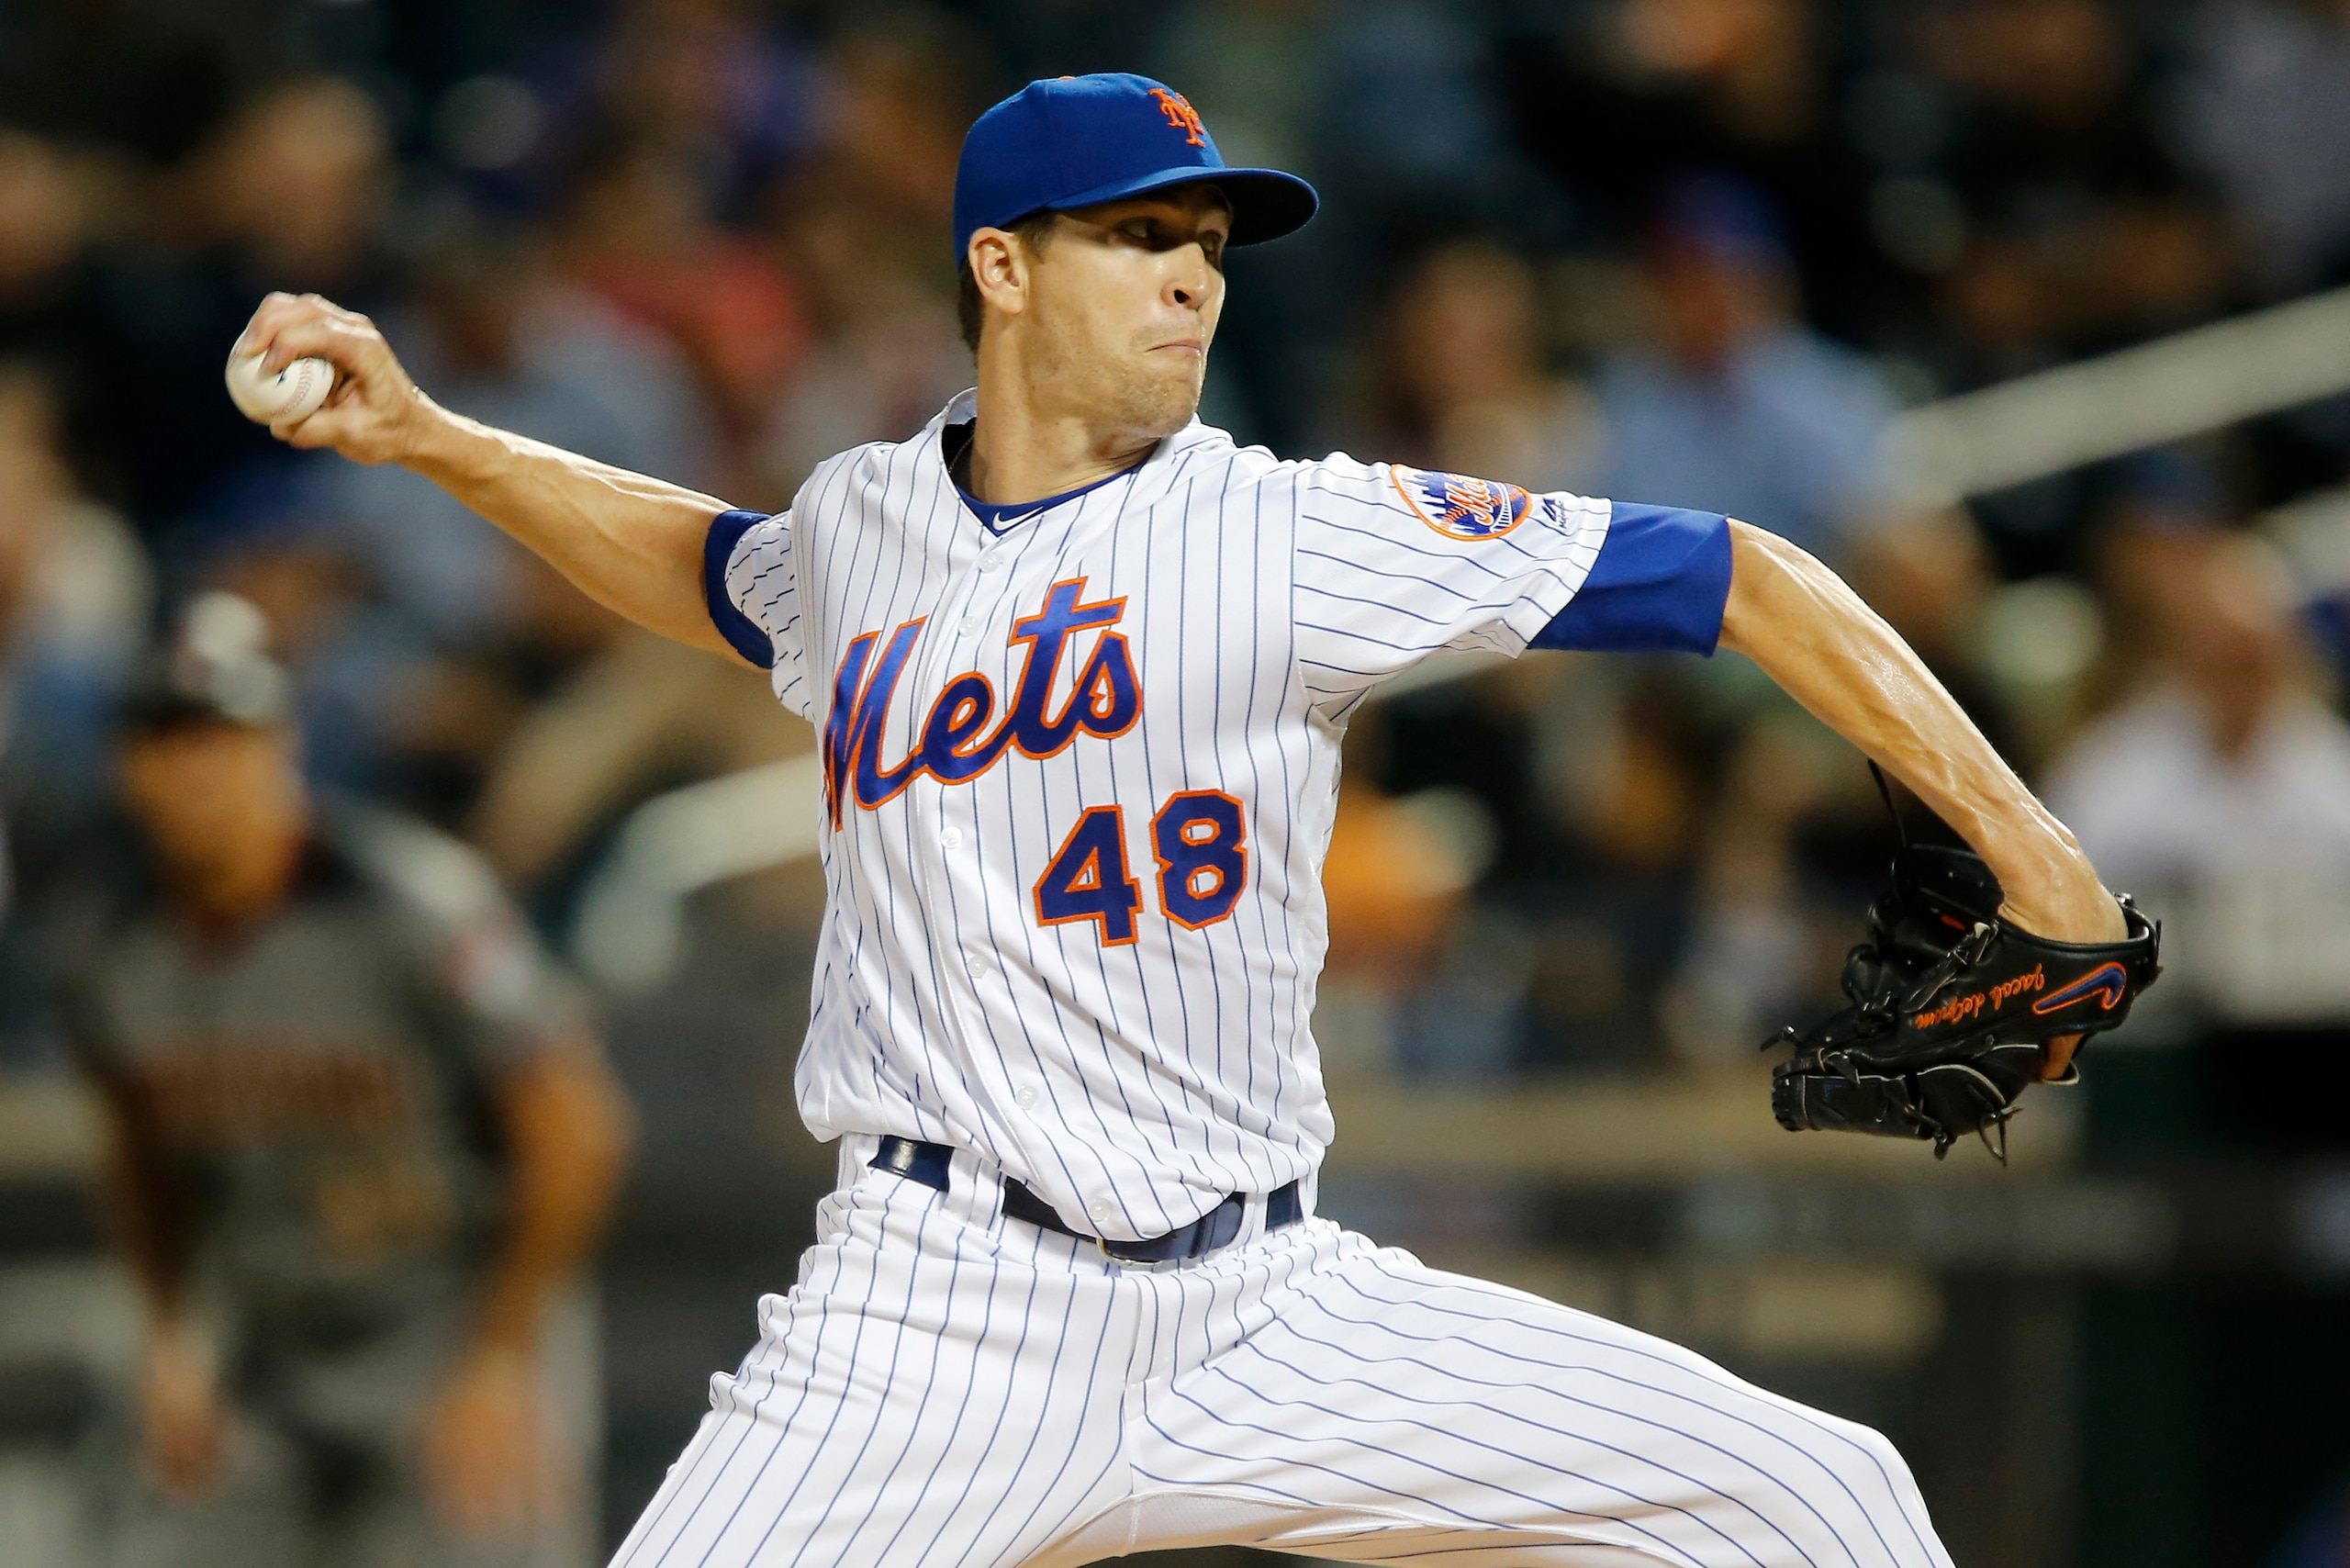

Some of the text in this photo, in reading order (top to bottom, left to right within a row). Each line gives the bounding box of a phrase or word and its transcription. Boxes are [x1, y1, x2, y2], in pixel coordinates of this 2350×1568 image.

[823, 577, 1143, 832] Mets
[1033, 790, 1248, 946] 48
[1989, 963, 2045, 1010] Jacob
